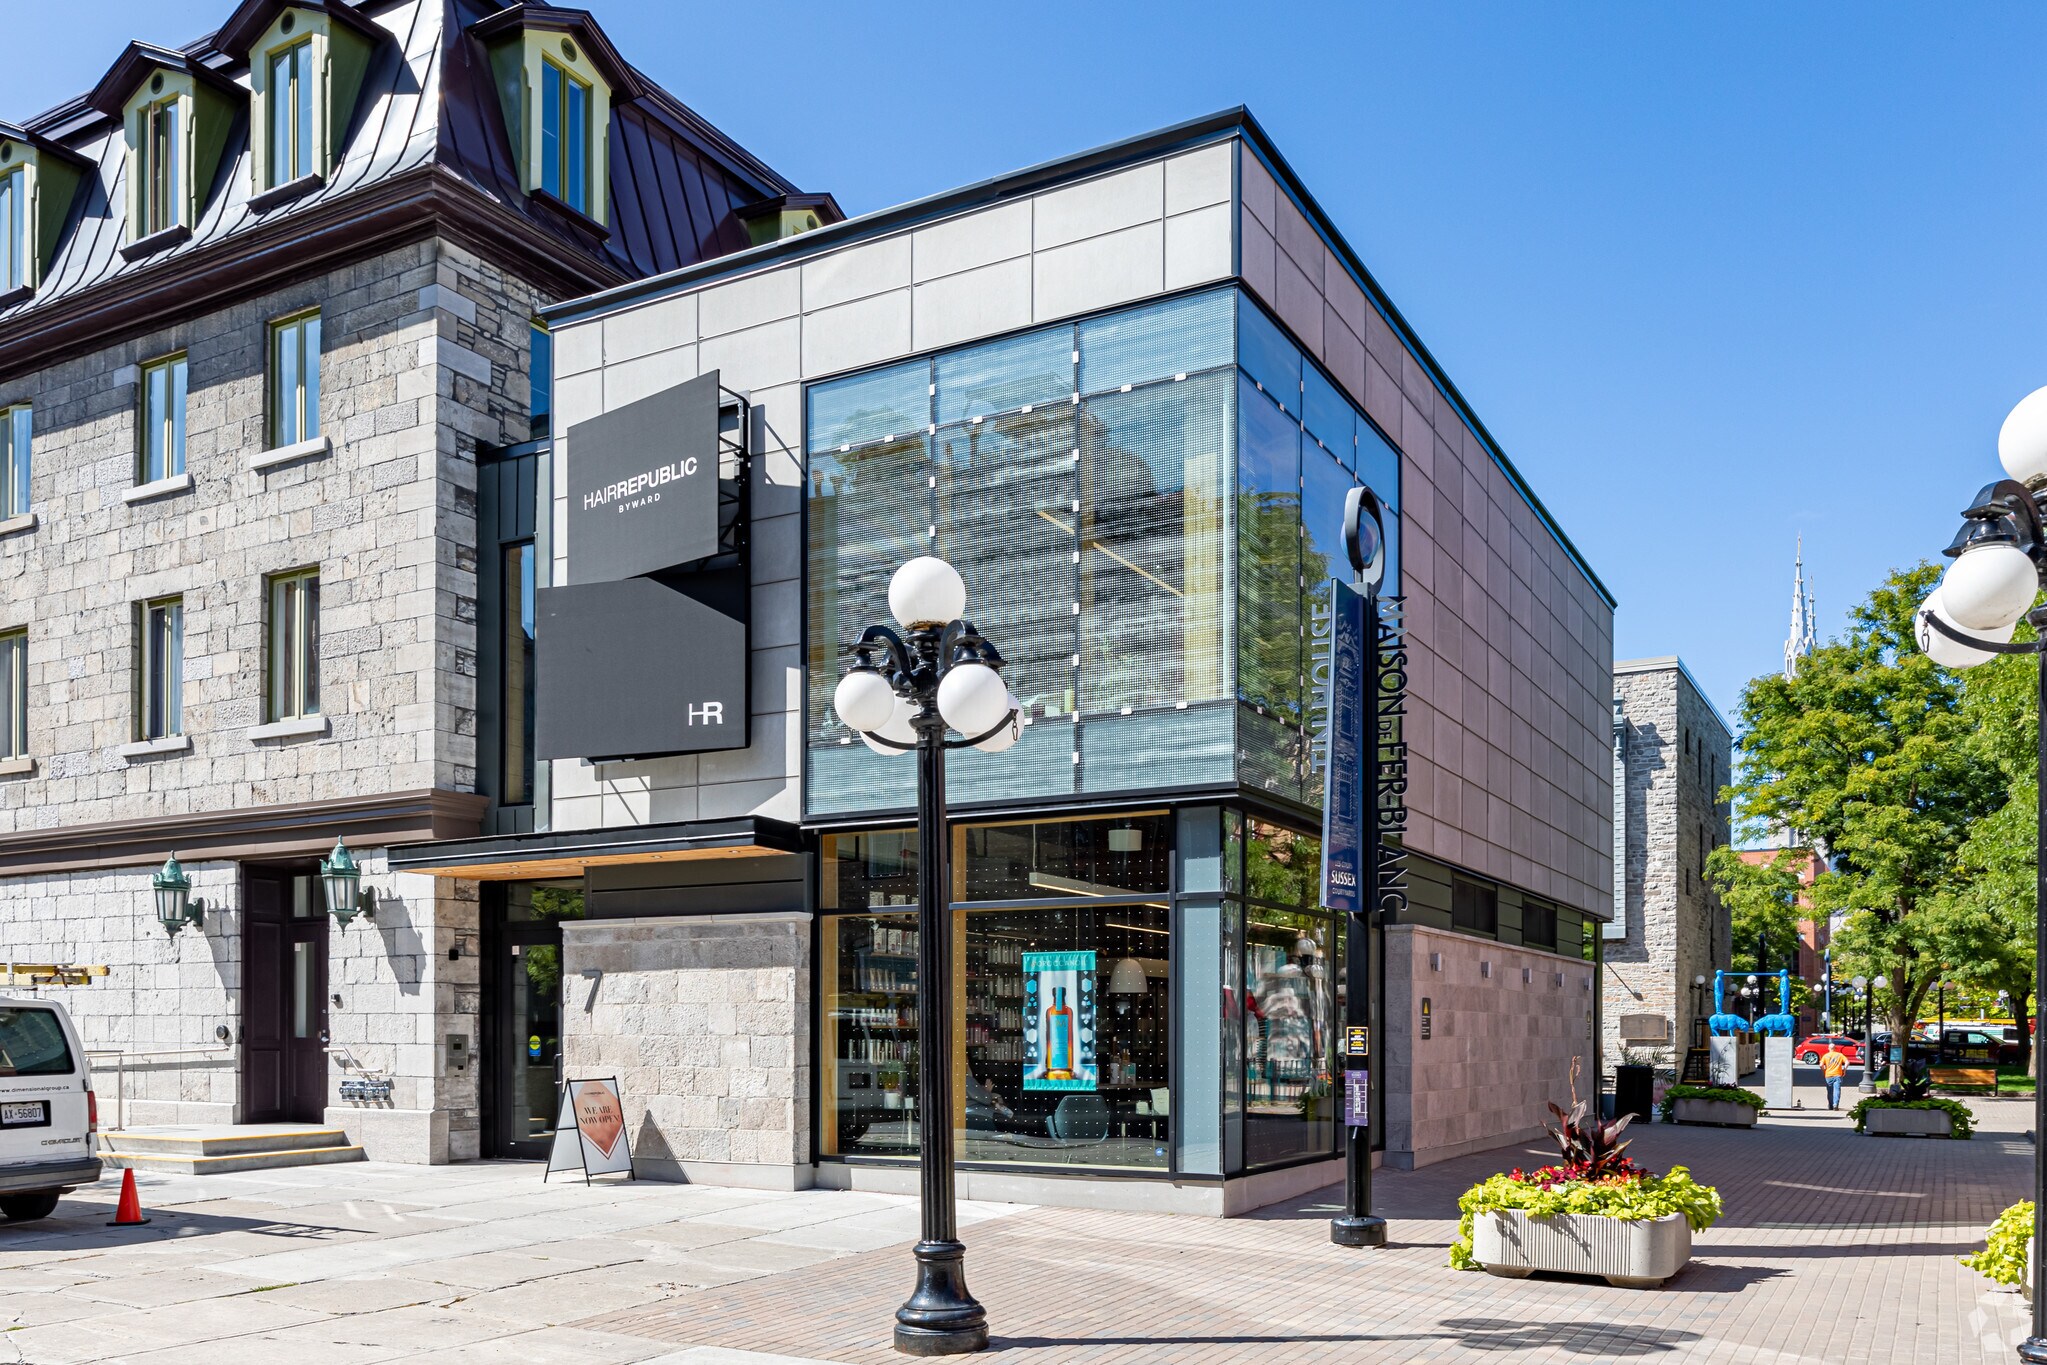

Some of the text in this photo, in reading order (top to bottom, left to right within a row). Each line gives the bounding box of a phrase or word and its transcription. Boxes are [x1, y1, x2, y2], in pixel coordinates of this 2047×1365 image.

[583, 456, 698, 511] HAIRREPUBLIC
[618, 492, 661, 514] BYWARD
[1311, 603, 1331, 774] TIN HOUSE
[688, 701, 724, 726] HR
[1377, 596, 1409, 913] MAISON DE FER-BLANC
[1331, 870, 1357, 887] SUSSEX
[581, 969, 603, 1014] 7
[0, 1085, 70, 1093] ww.dimensionalgroup.ca
[4, 1107, 42, 1120] AX 56807
[584, 1105, 613, 1115] WE ARE
[580, 1115, 621, 1125] NOW OPEN!
[41, 1137, 83, 1146] CHEVROLET
